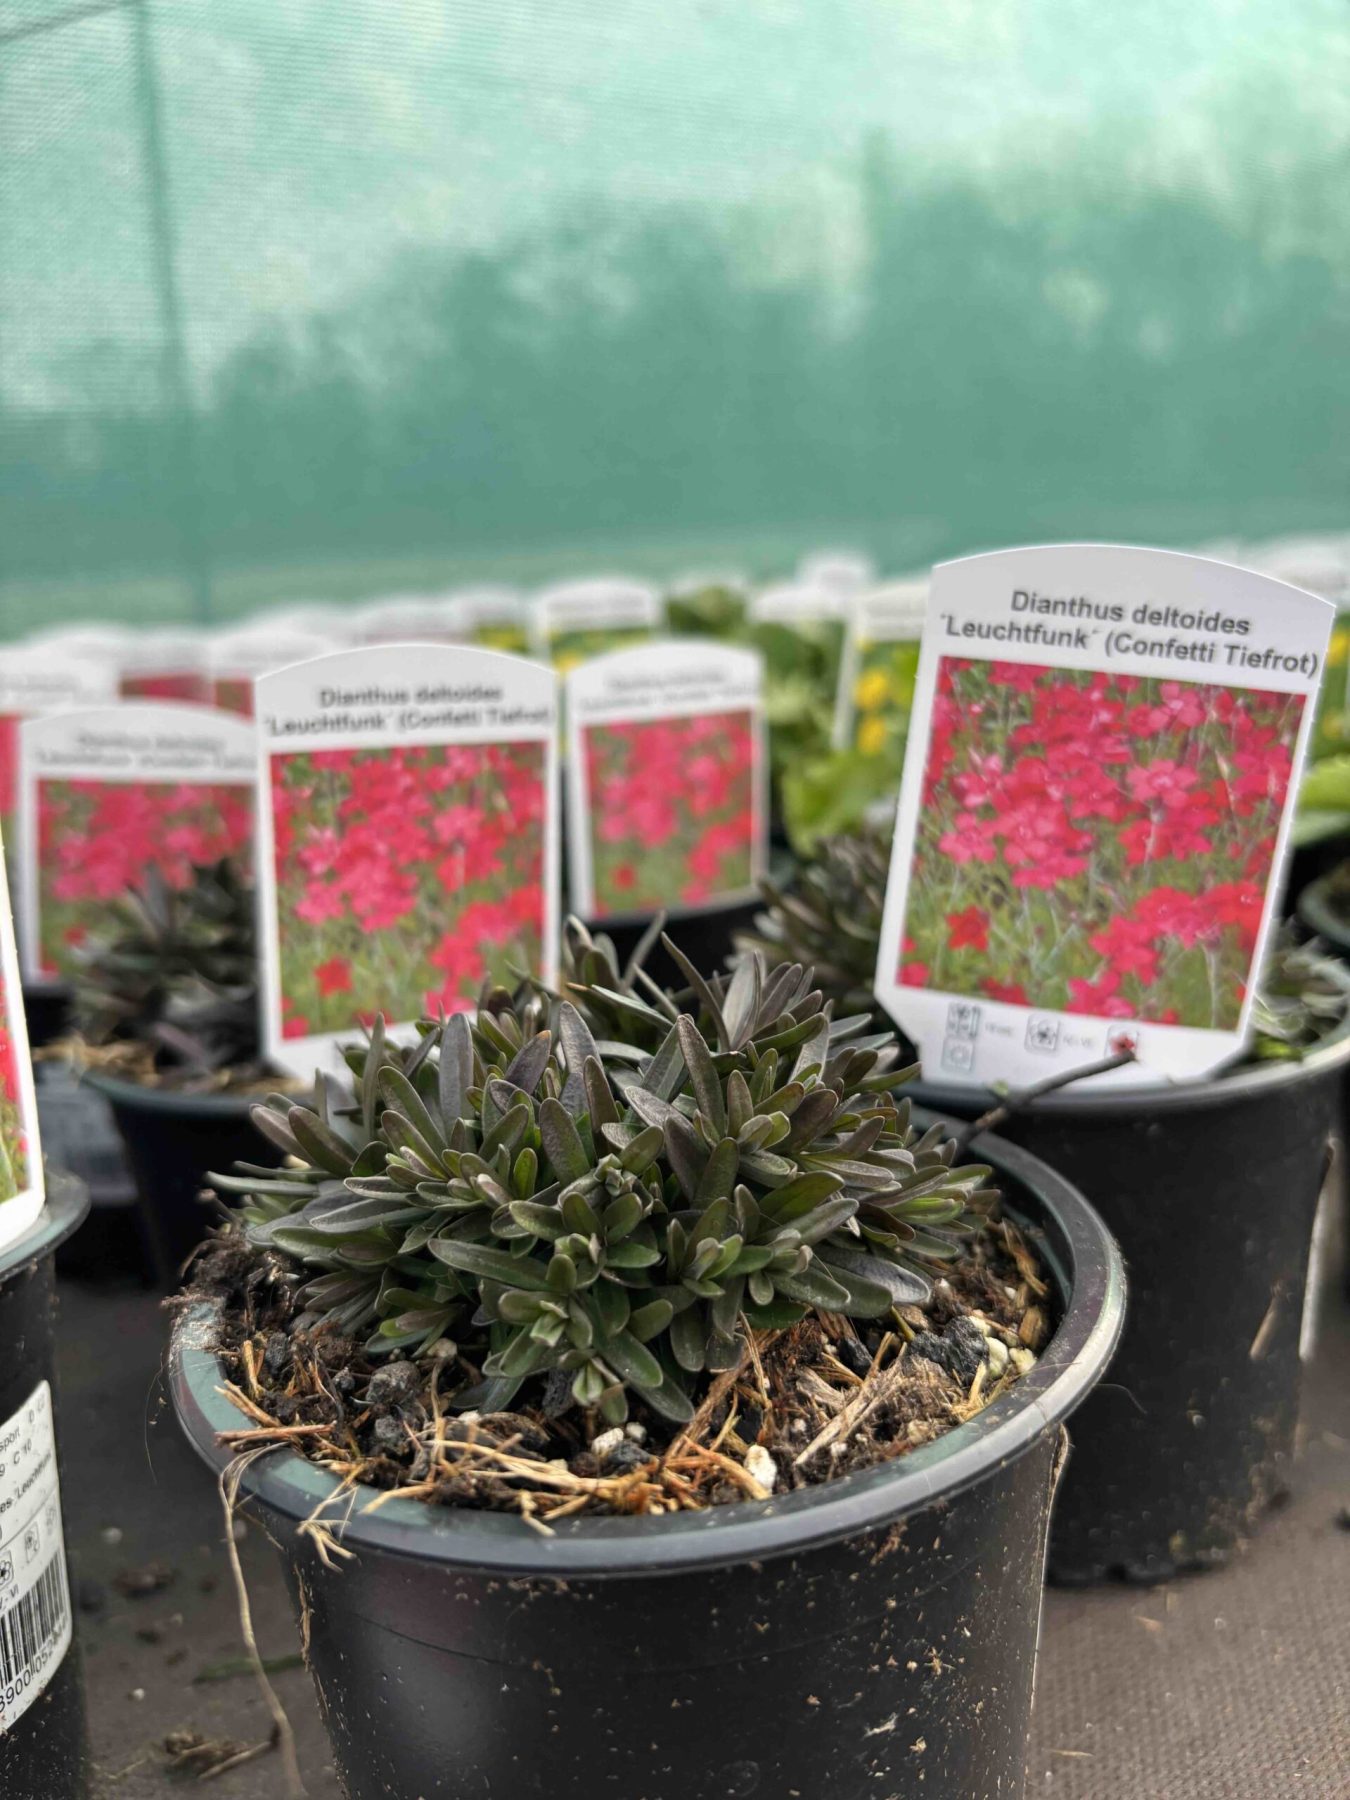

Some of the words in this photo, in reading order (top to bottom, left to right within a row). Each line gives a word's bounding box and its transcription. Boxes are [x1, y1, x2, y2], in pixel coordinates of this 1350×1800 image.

[1011, 591, 1123, 622] Dianthus
[1132, 604, 1250, 636] deltoides
[1104, 631, 1215, 662] (Confetti
[1224, 645, 1319, 678] Tiefrot)
[320, 685, 409, 708] Dianthus
